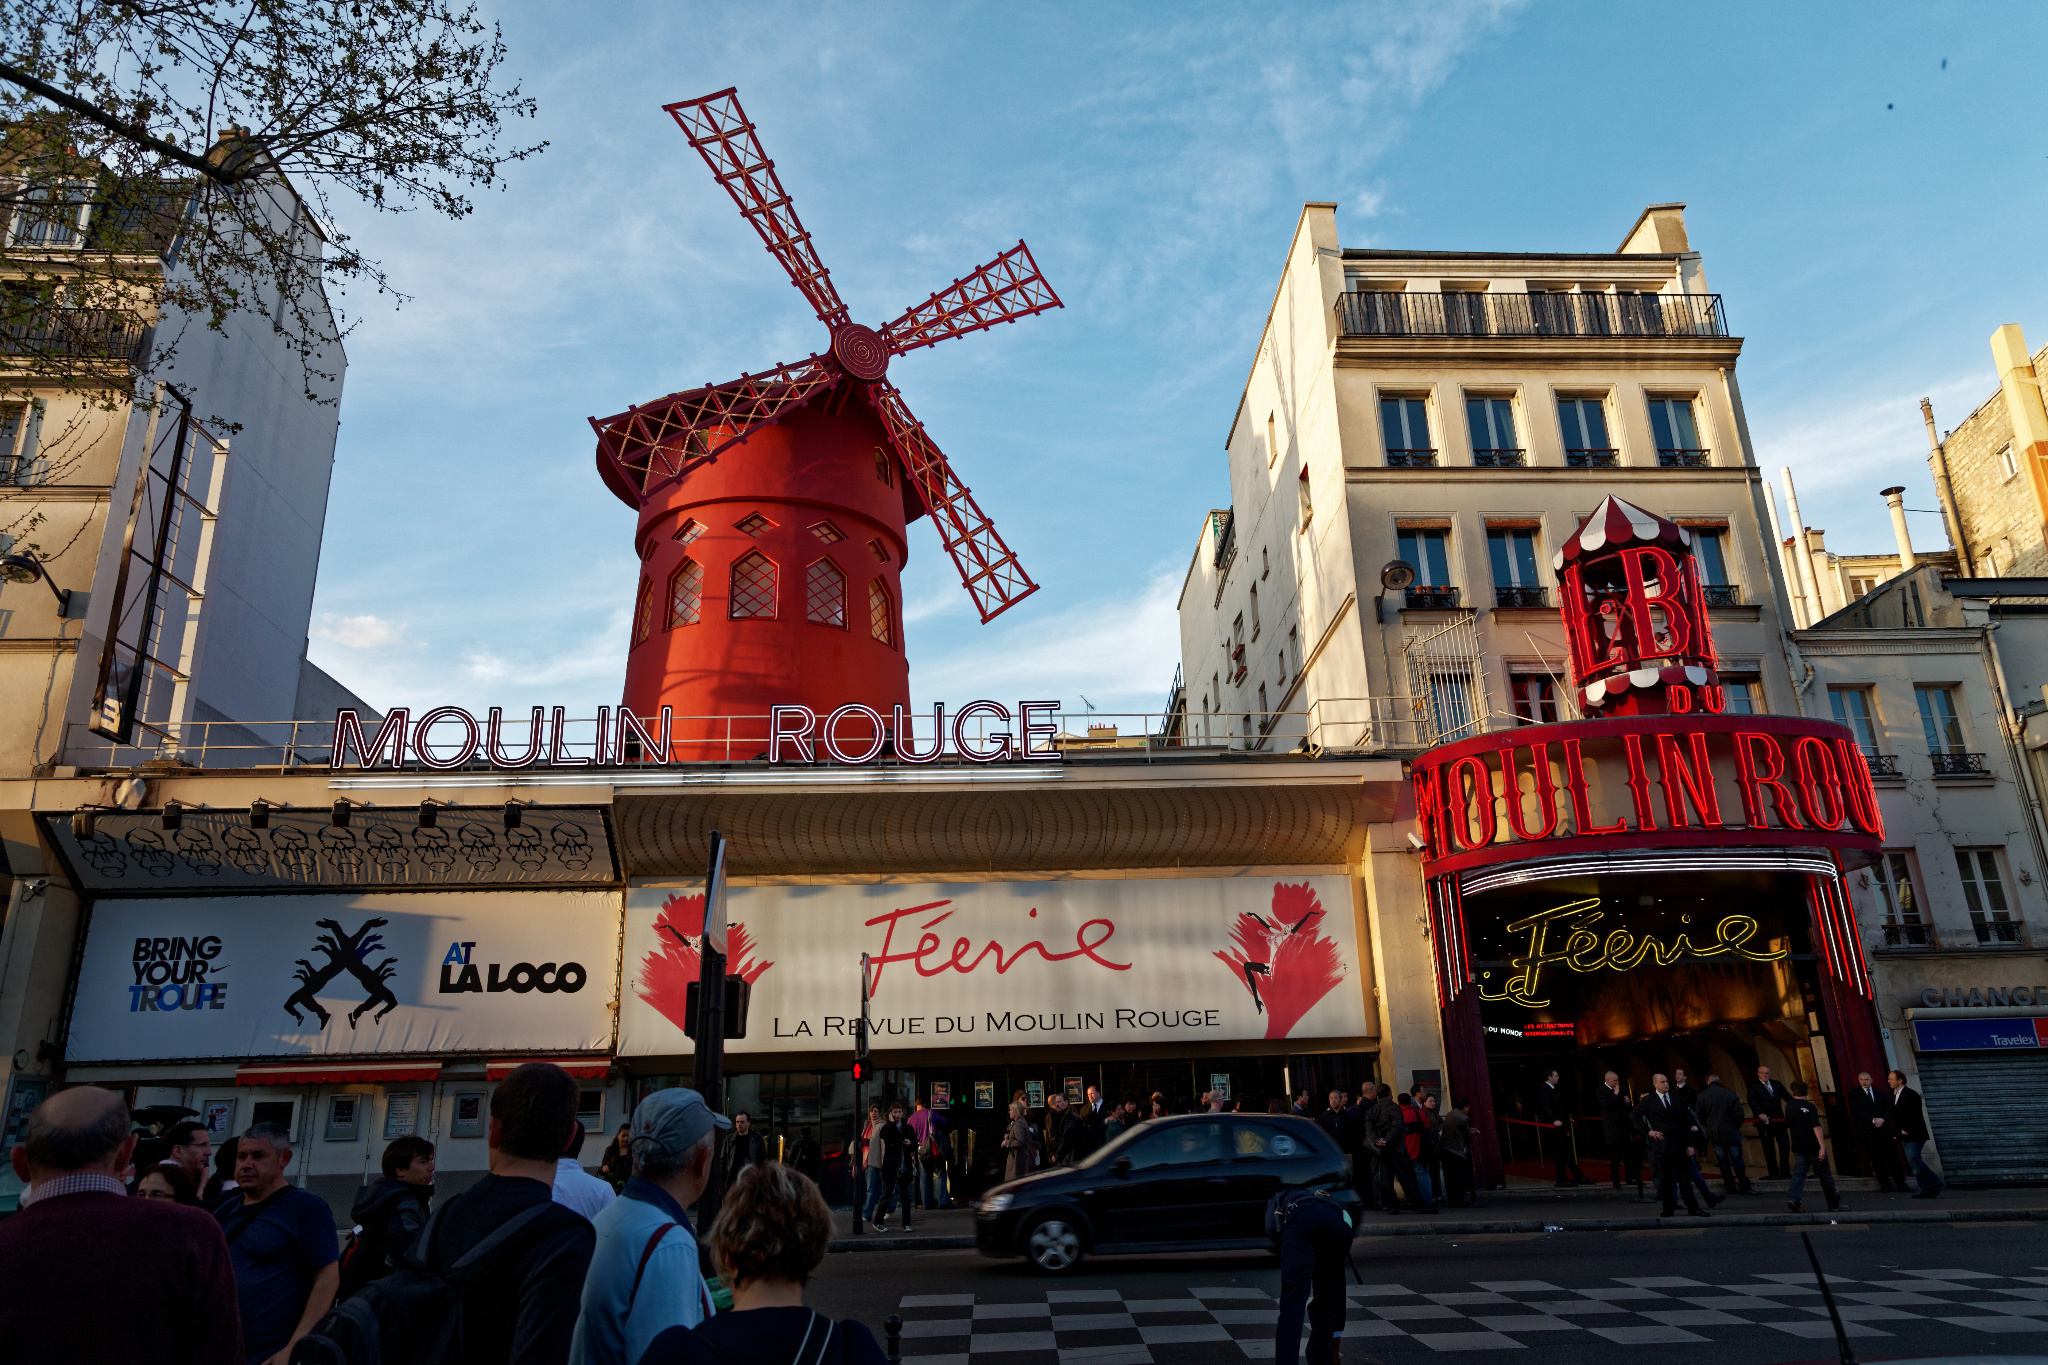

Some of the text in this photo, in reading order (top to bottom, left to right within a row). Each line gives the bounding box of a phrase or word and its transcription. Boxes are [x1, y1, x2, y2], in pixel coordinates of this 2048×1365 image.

[1671, 685, 1726, 713] DU
[330, 700, 1064, 769] MOULIN ROUGE
[1413, 732, 1723, 862] MOULIN
[132, 935, 222, 962] BRING
[442, 941, 477, 965] AT
[132, 960, 210, 985] YOUR
[486, 962, 588, 994] LOCO
[129, 982, 228, 1012] TROUPE
[1921, 986, 2048, 1008] CHANGE
[1500, 1027, 1523, 1038] MONDE
[1991, 1034, 2036, 1046] Travelex
